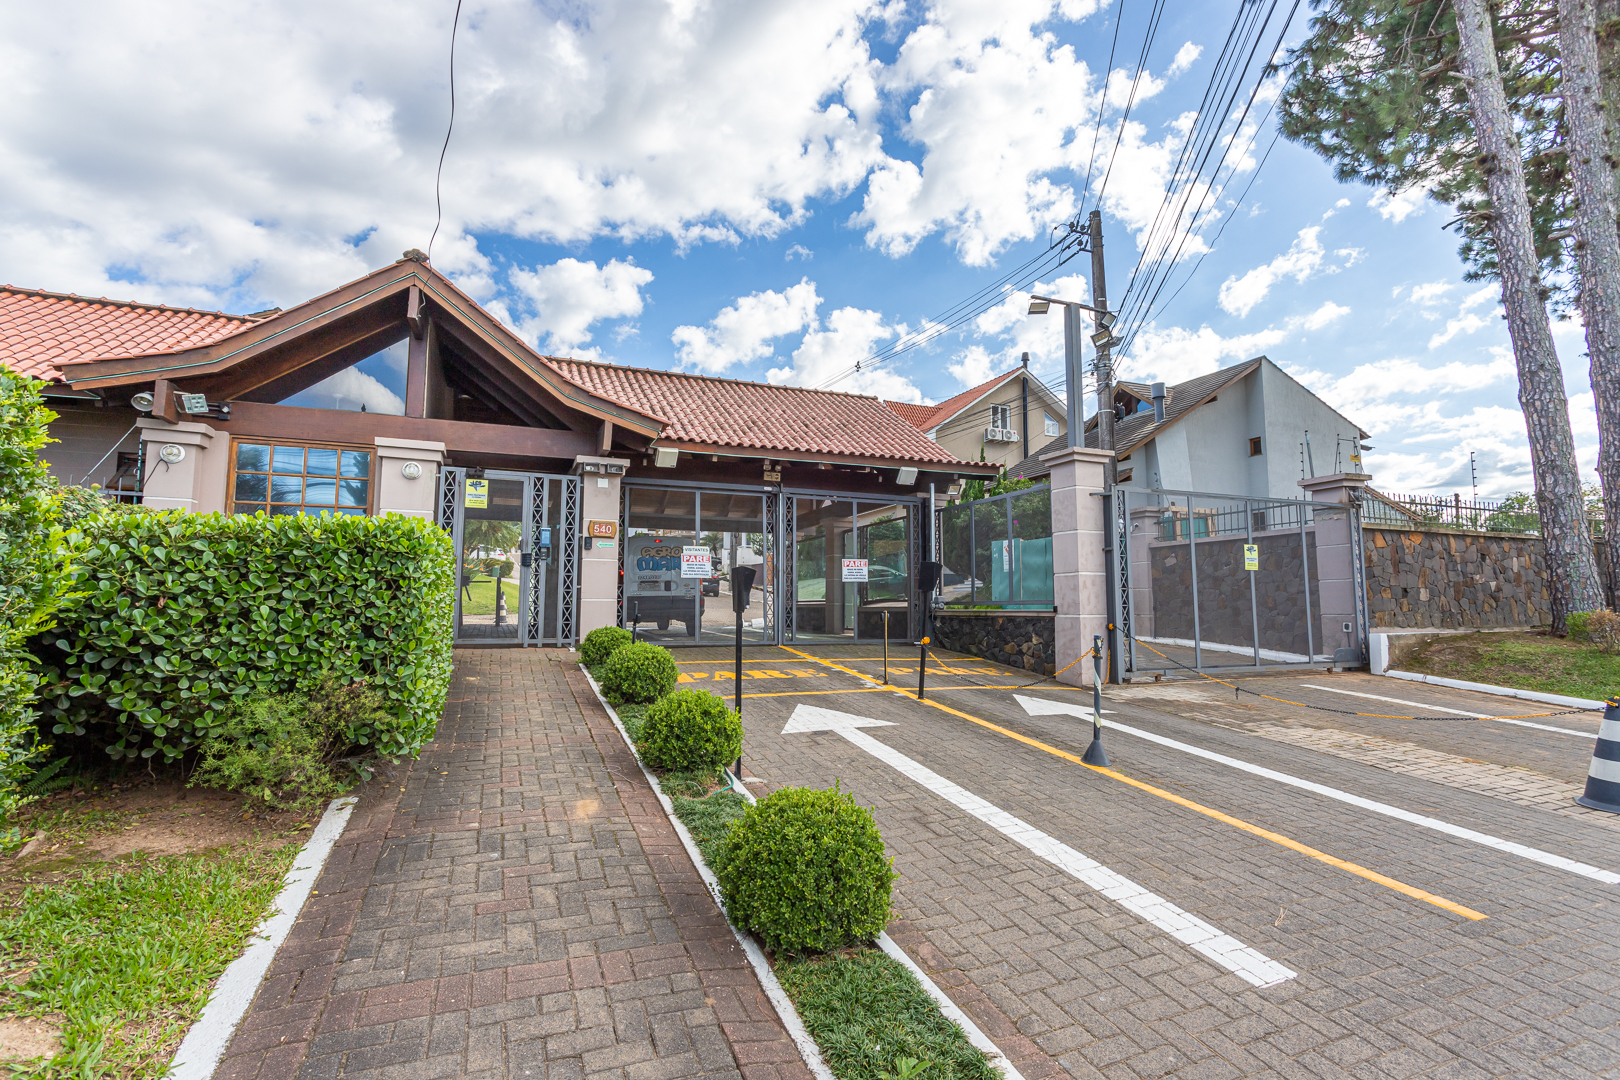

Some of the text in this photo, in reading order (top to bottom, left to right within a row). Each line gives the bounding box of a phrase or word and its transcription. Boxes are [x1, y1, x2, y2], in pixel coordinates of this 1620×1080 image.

[593, 524, 612, 534] 540
[641, 546, 683, 557] AGRO
[677, 669, 828, 683] PARE
